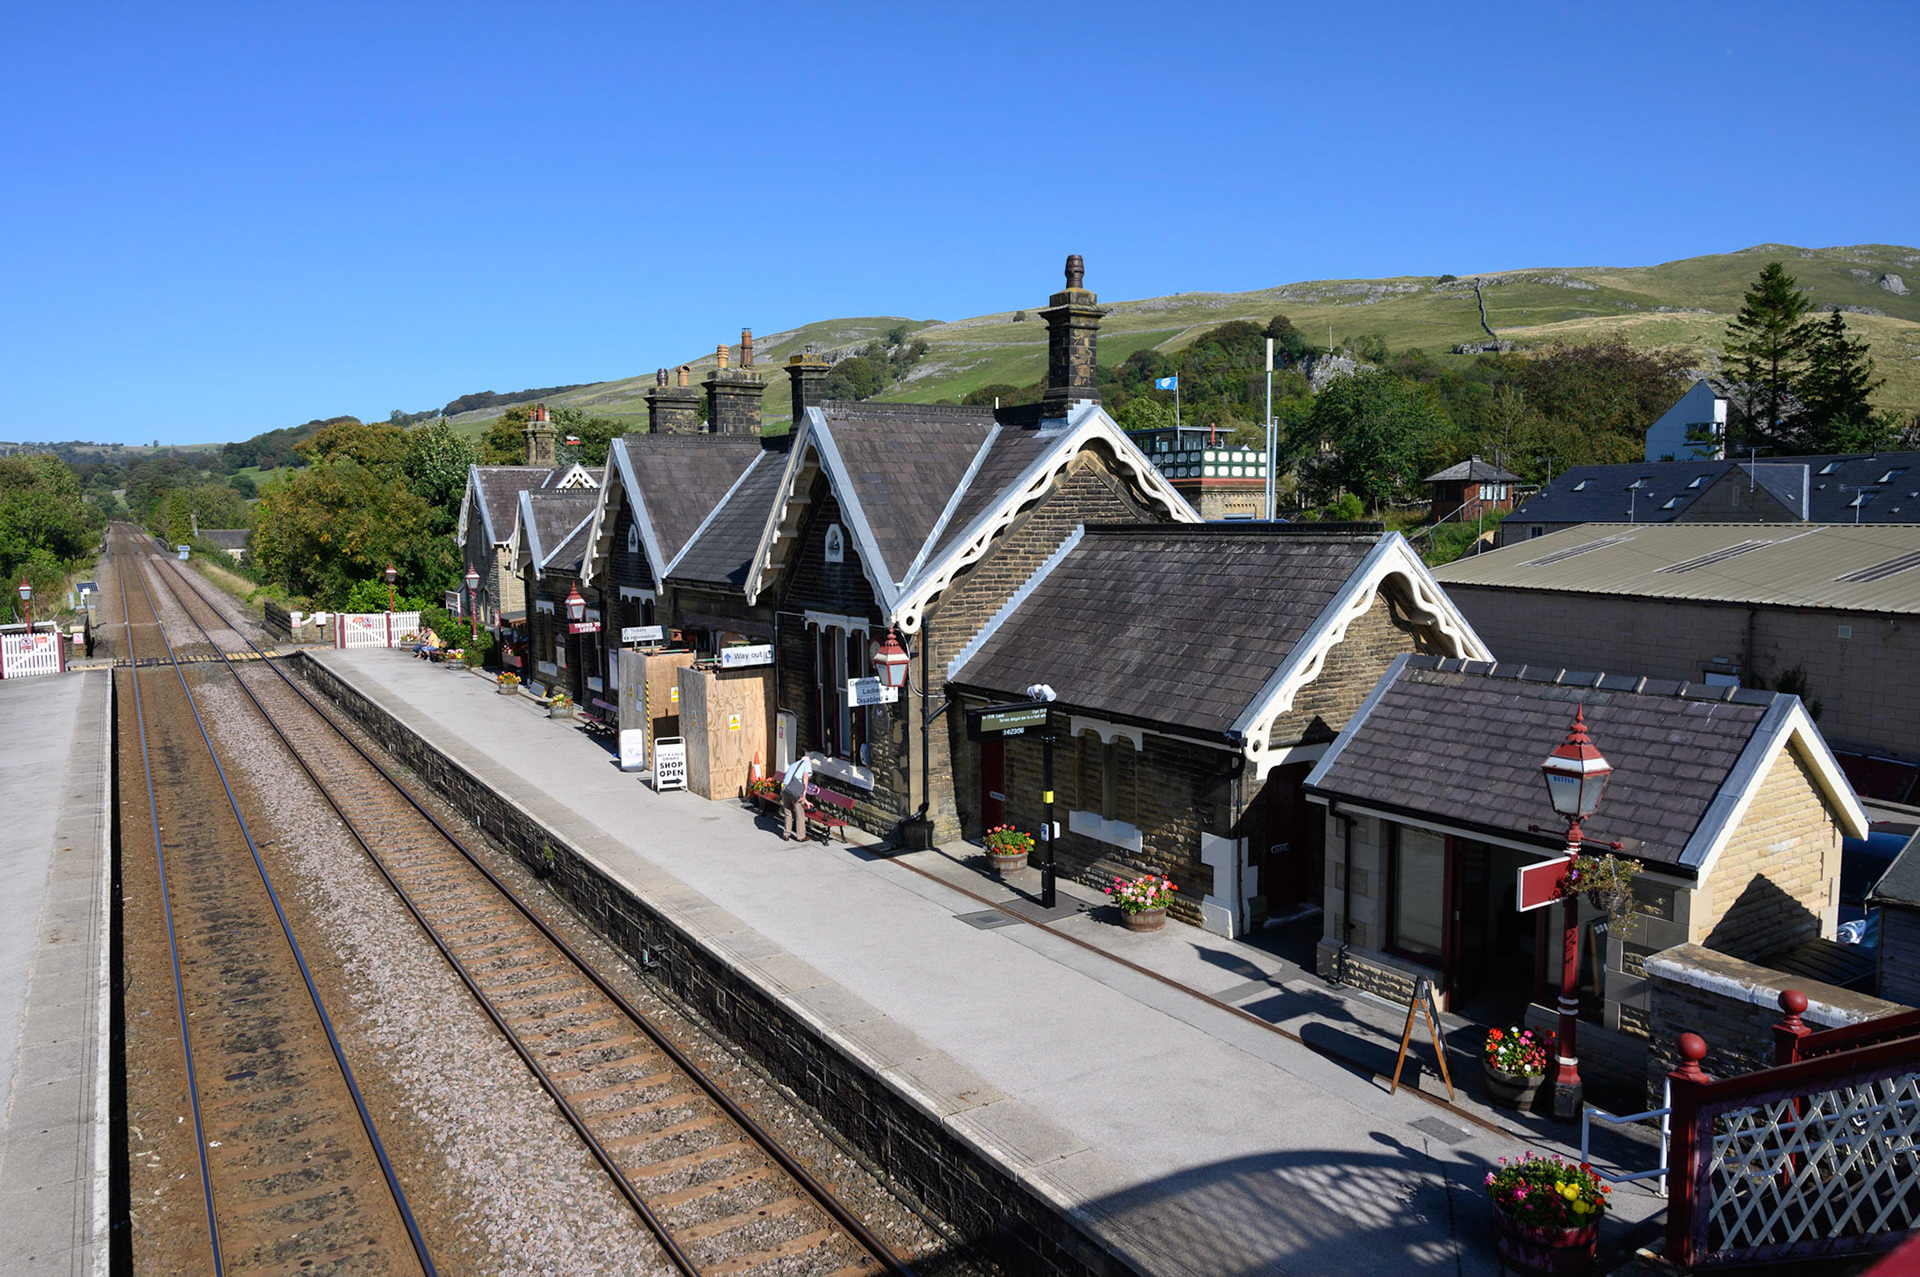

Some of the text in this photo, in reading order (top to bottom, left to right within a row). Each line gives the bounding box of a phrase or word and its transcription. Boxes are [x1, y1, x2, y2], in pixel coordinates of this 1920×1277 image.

[734, 652, 749, 660] Way
[857, 695, 883, 704] Disabled
[660, 761, 683, 769] SHOP
[659, 769, 684, 777] OPEN
